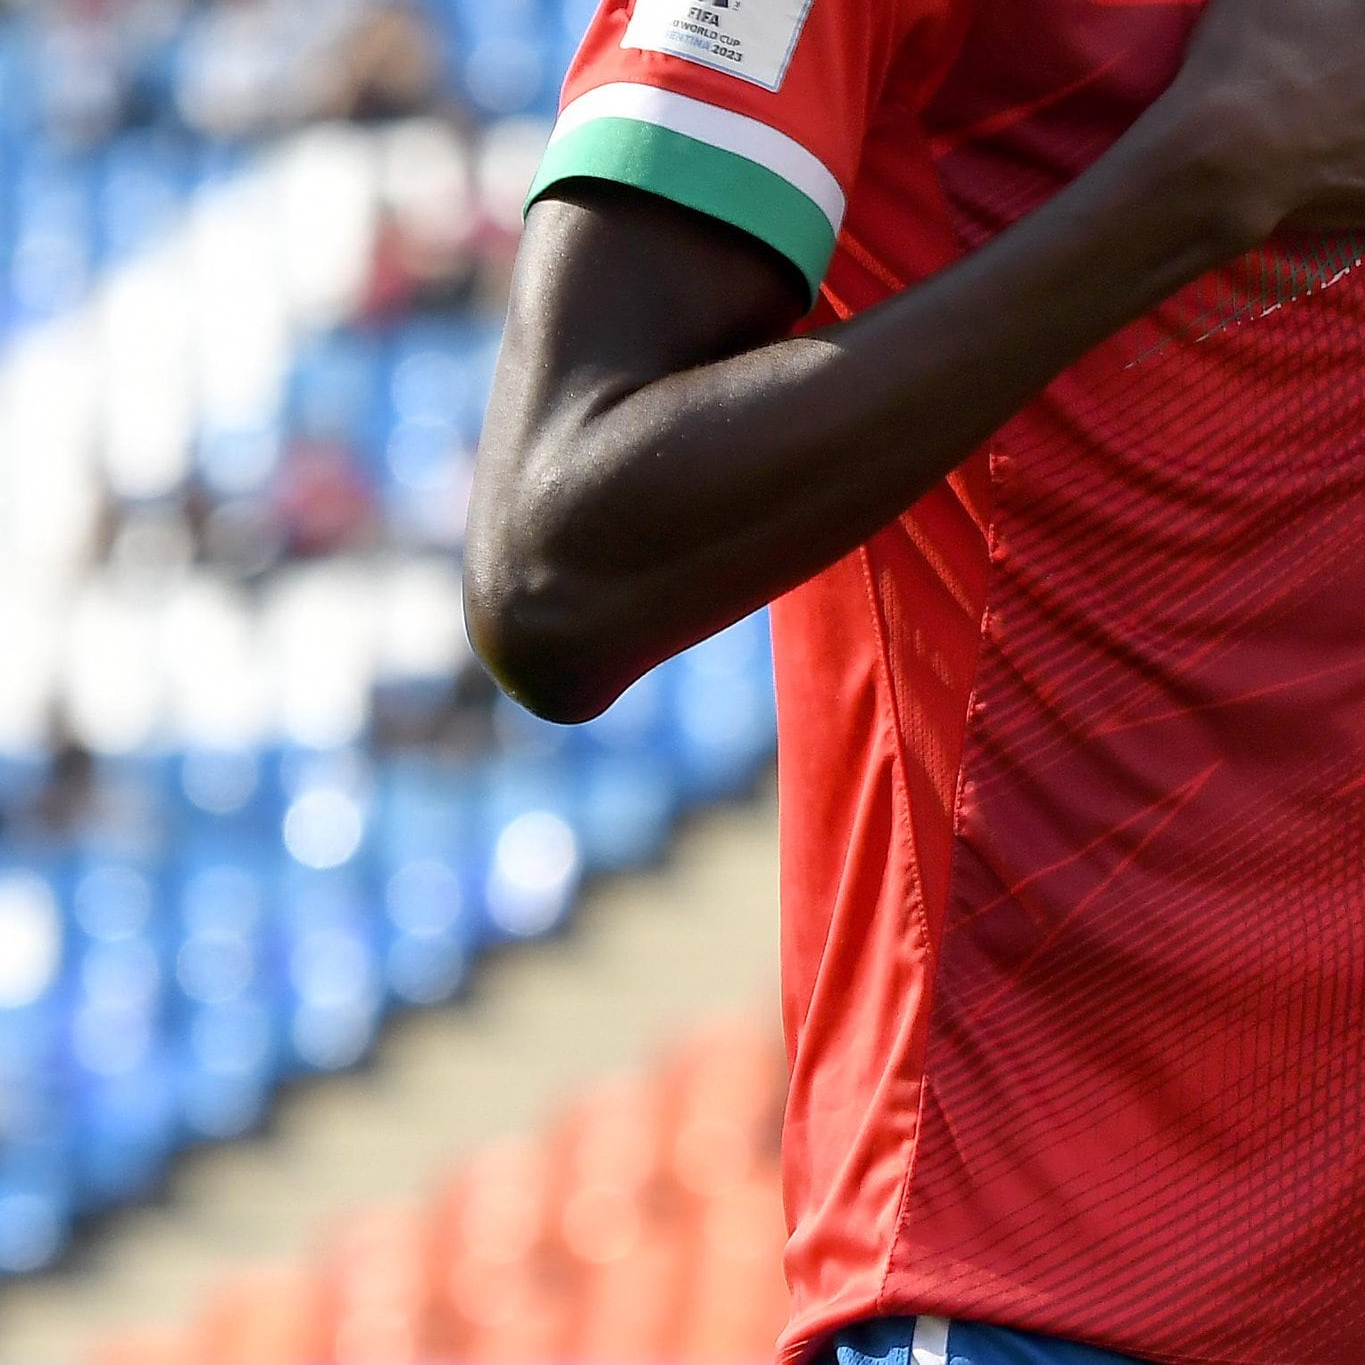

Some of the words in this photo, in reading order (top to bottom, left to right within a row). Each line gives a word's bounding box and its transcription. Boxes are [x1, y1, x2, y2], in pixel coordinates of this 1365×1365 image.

[687, 6, 719, 27] FIFA
[681, 21, 719, 40] WORLD
[719, 35, 741, 47] CUP
[711, 44, 743, 62] 2023
